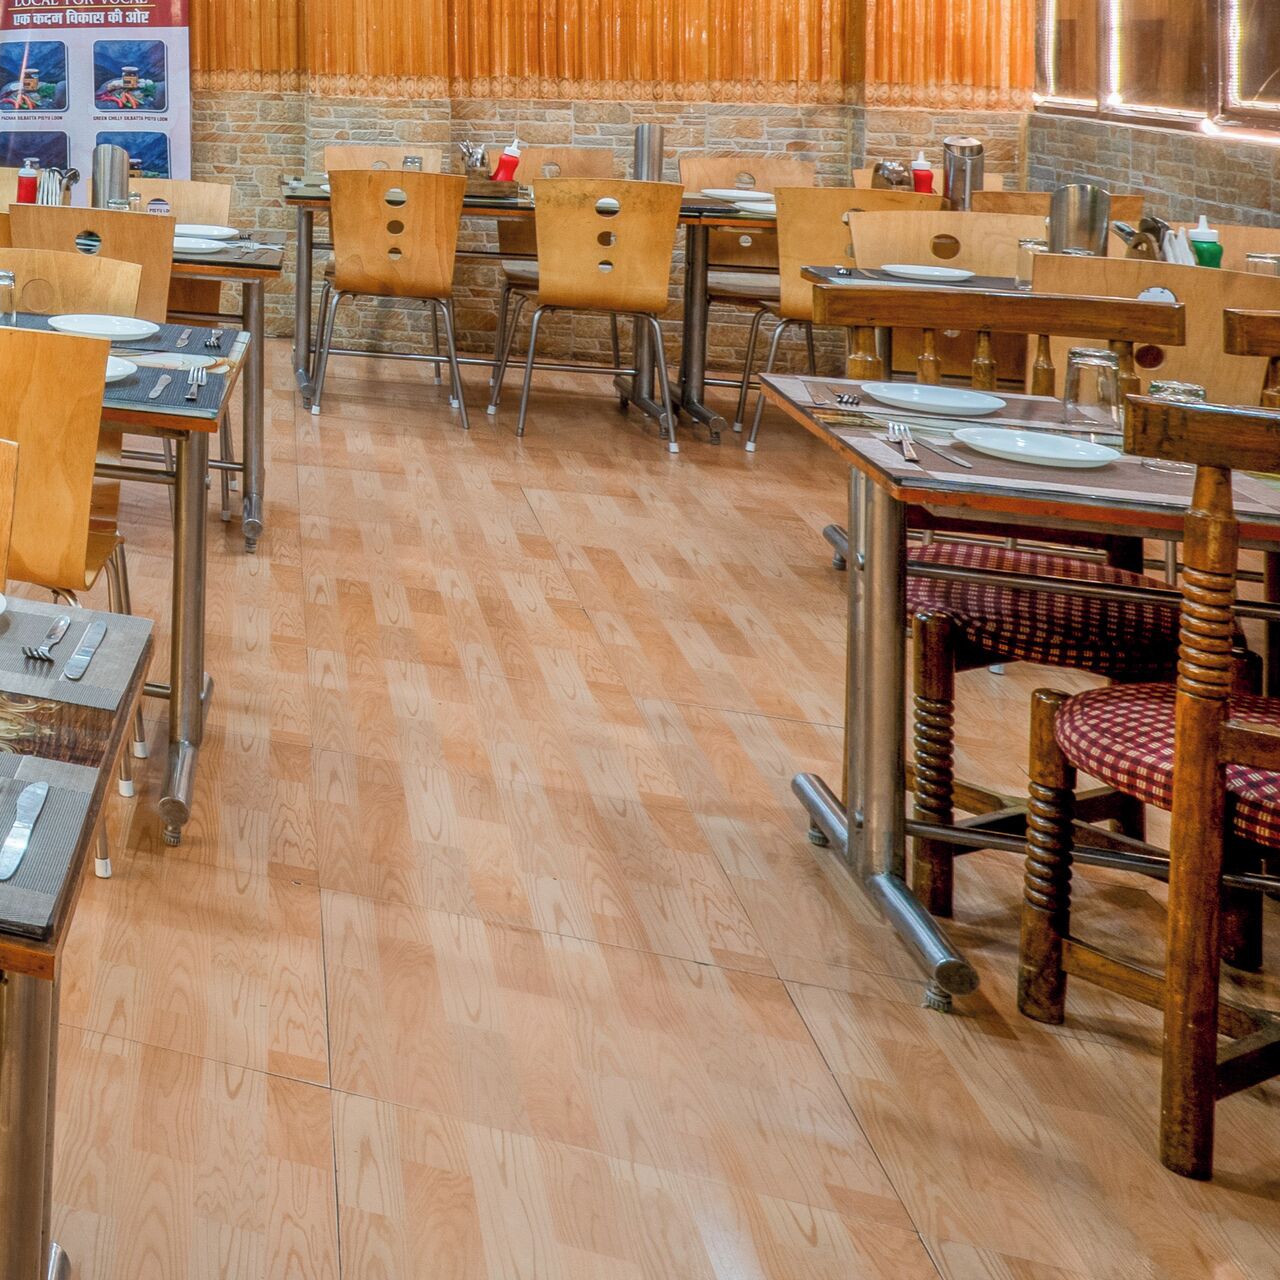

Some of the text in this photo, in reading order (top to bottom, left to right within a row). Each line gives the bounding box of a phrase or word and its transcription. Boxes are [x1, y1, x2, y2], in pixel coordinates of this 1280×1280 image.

[13, 8, 150, 26] एक कदम विकास की ओर
